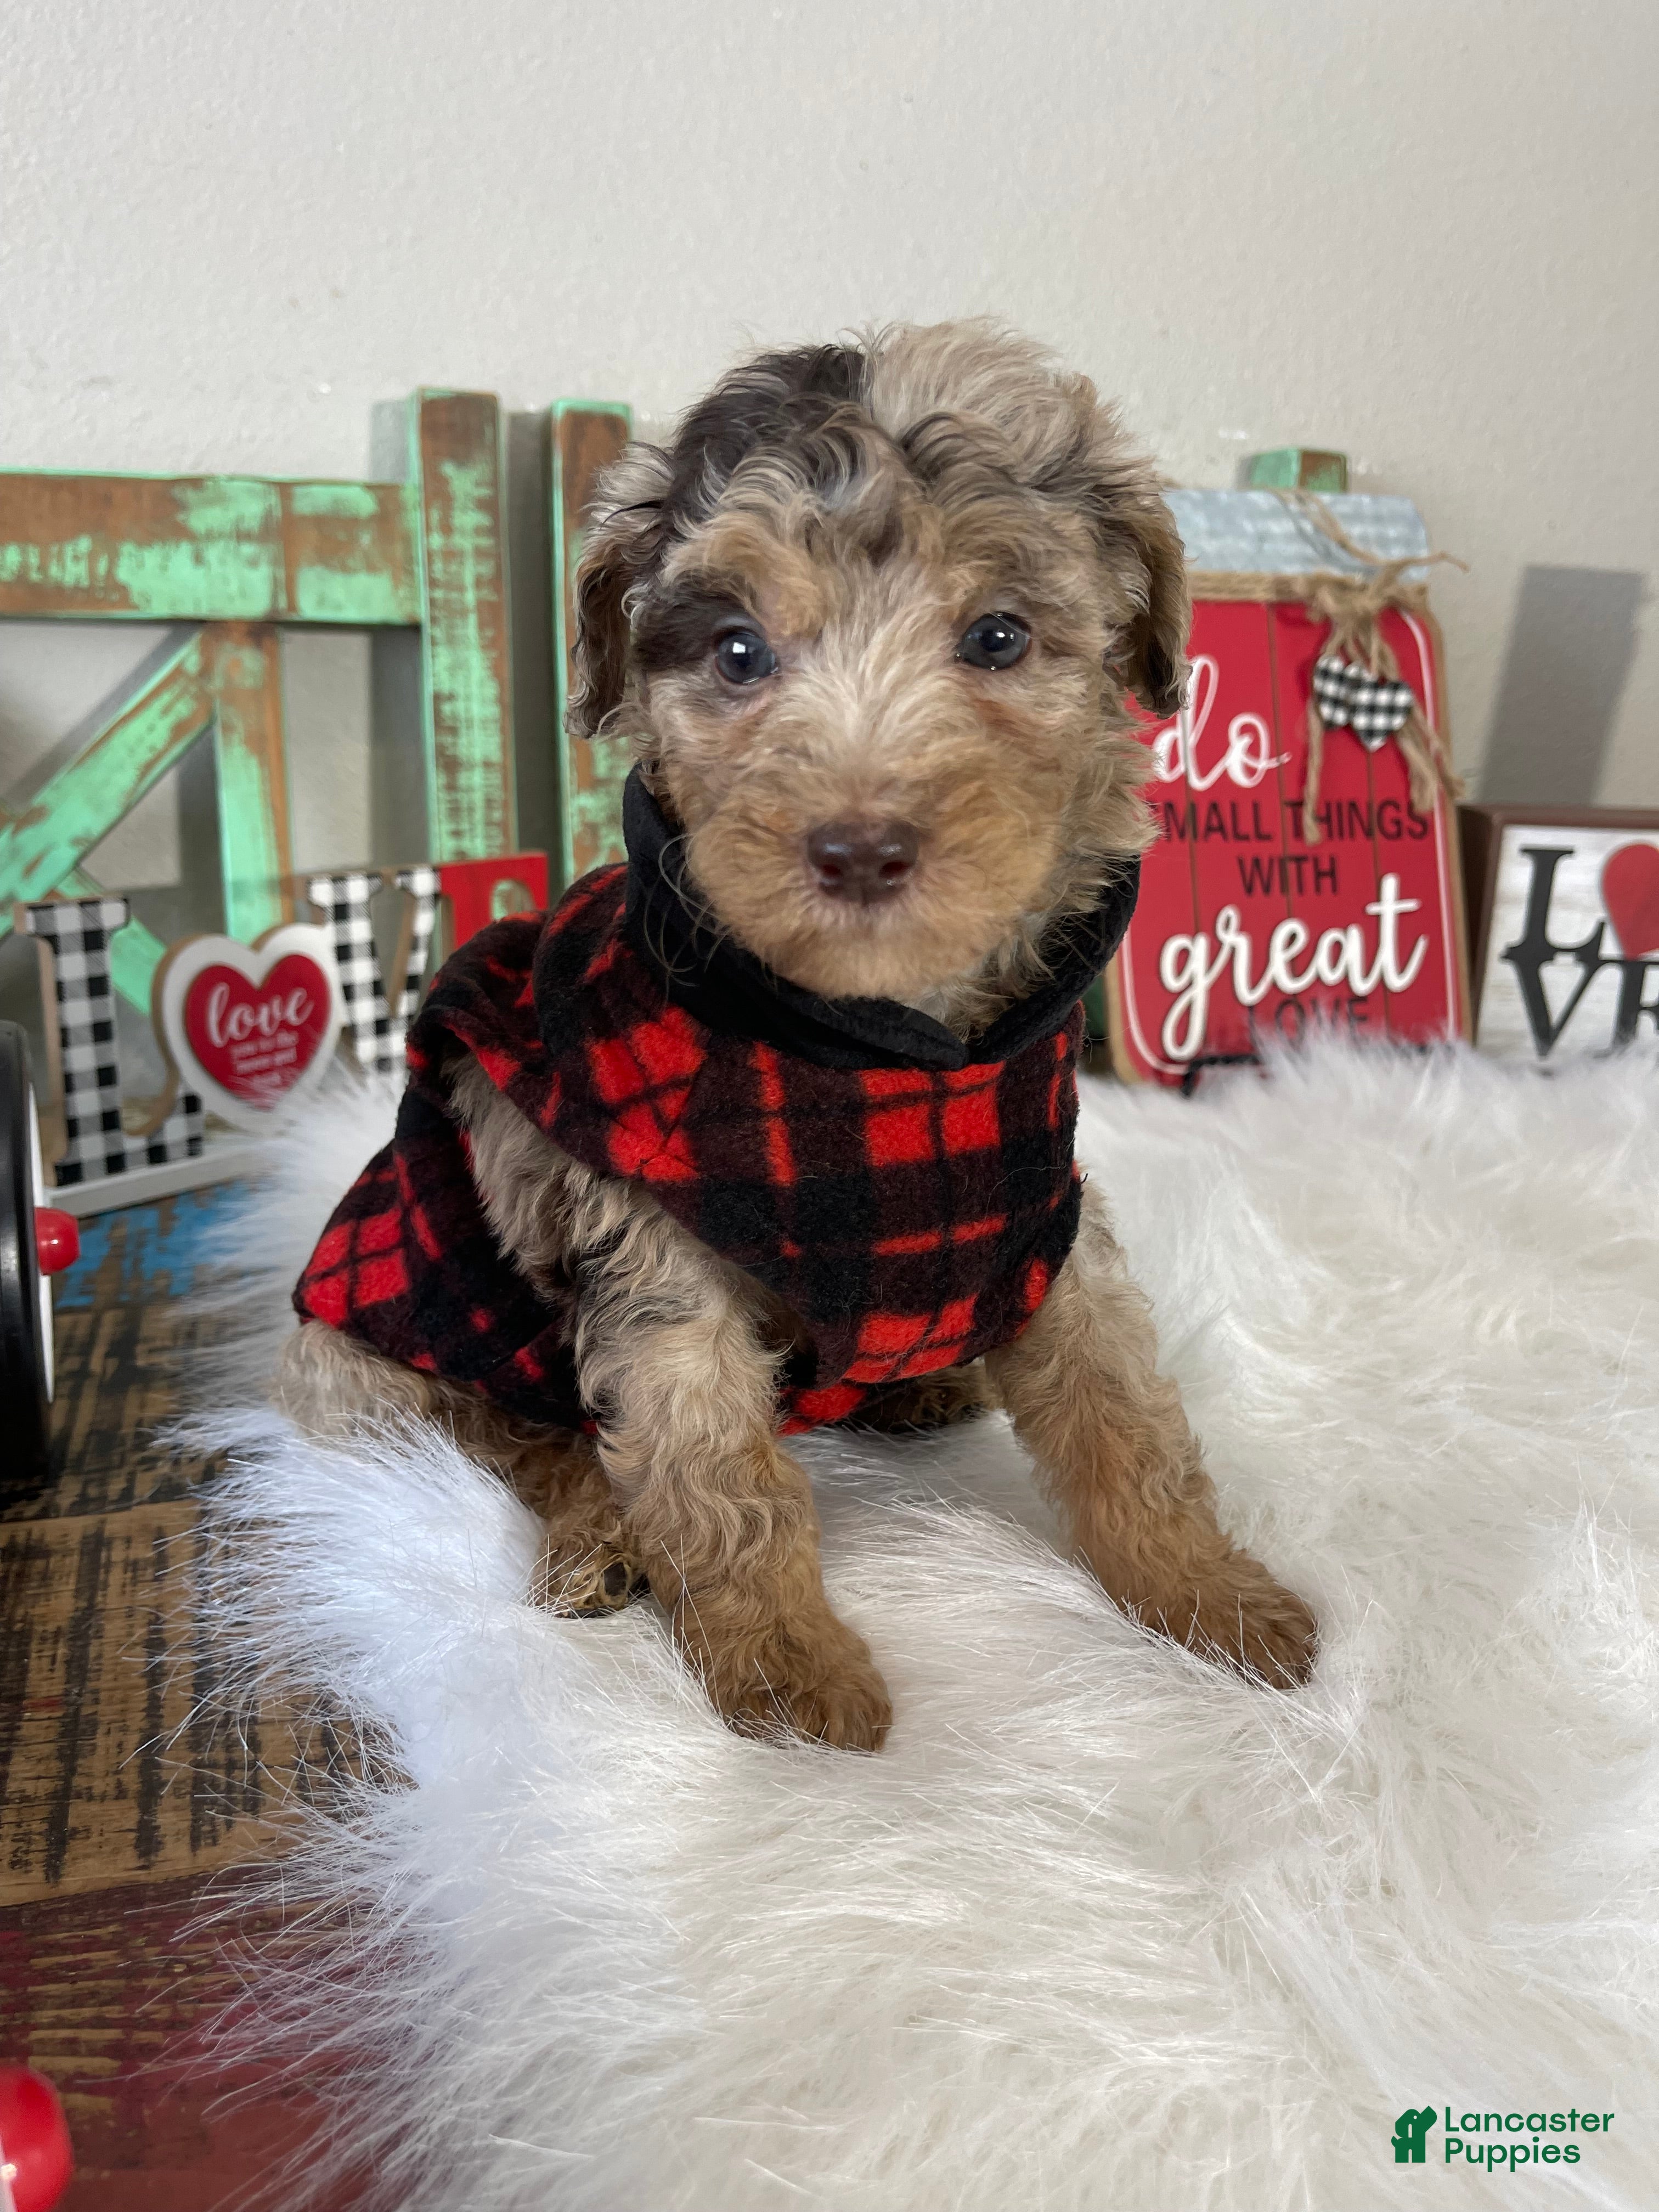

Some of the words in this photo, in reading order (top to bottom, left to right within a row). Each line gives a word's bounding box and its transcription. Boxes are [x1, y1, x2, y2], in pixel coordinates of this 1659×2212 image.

[1152, 654, 1292, 791] do
[1143, 800, 1274, 843] MALL
[1283, 800, 1429, 843] THINGS
[1237, 856, 1339, 897] WITH
[1160, 873, 1429, 1062] great
[206, 981, 316, 1048] love
